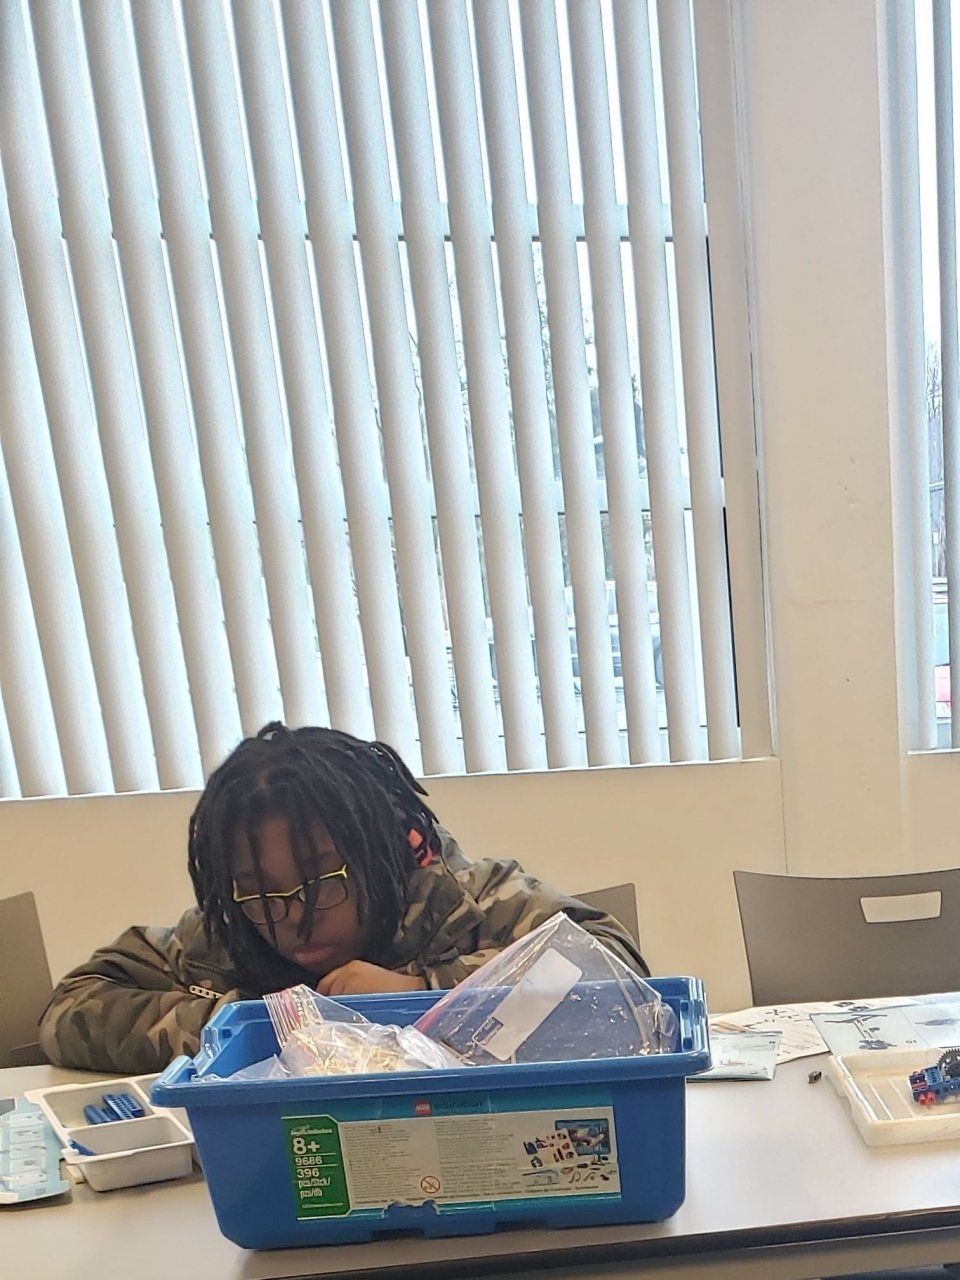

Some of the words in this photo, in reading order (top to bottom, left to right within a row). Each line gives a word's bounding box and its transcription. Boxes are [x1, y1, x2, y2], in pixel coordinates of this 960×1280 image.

[293, 1137, 320, 1154] 8+
[295, 1156, 323, 1165] 9686
[296, 1168, 320, 1178] 396
